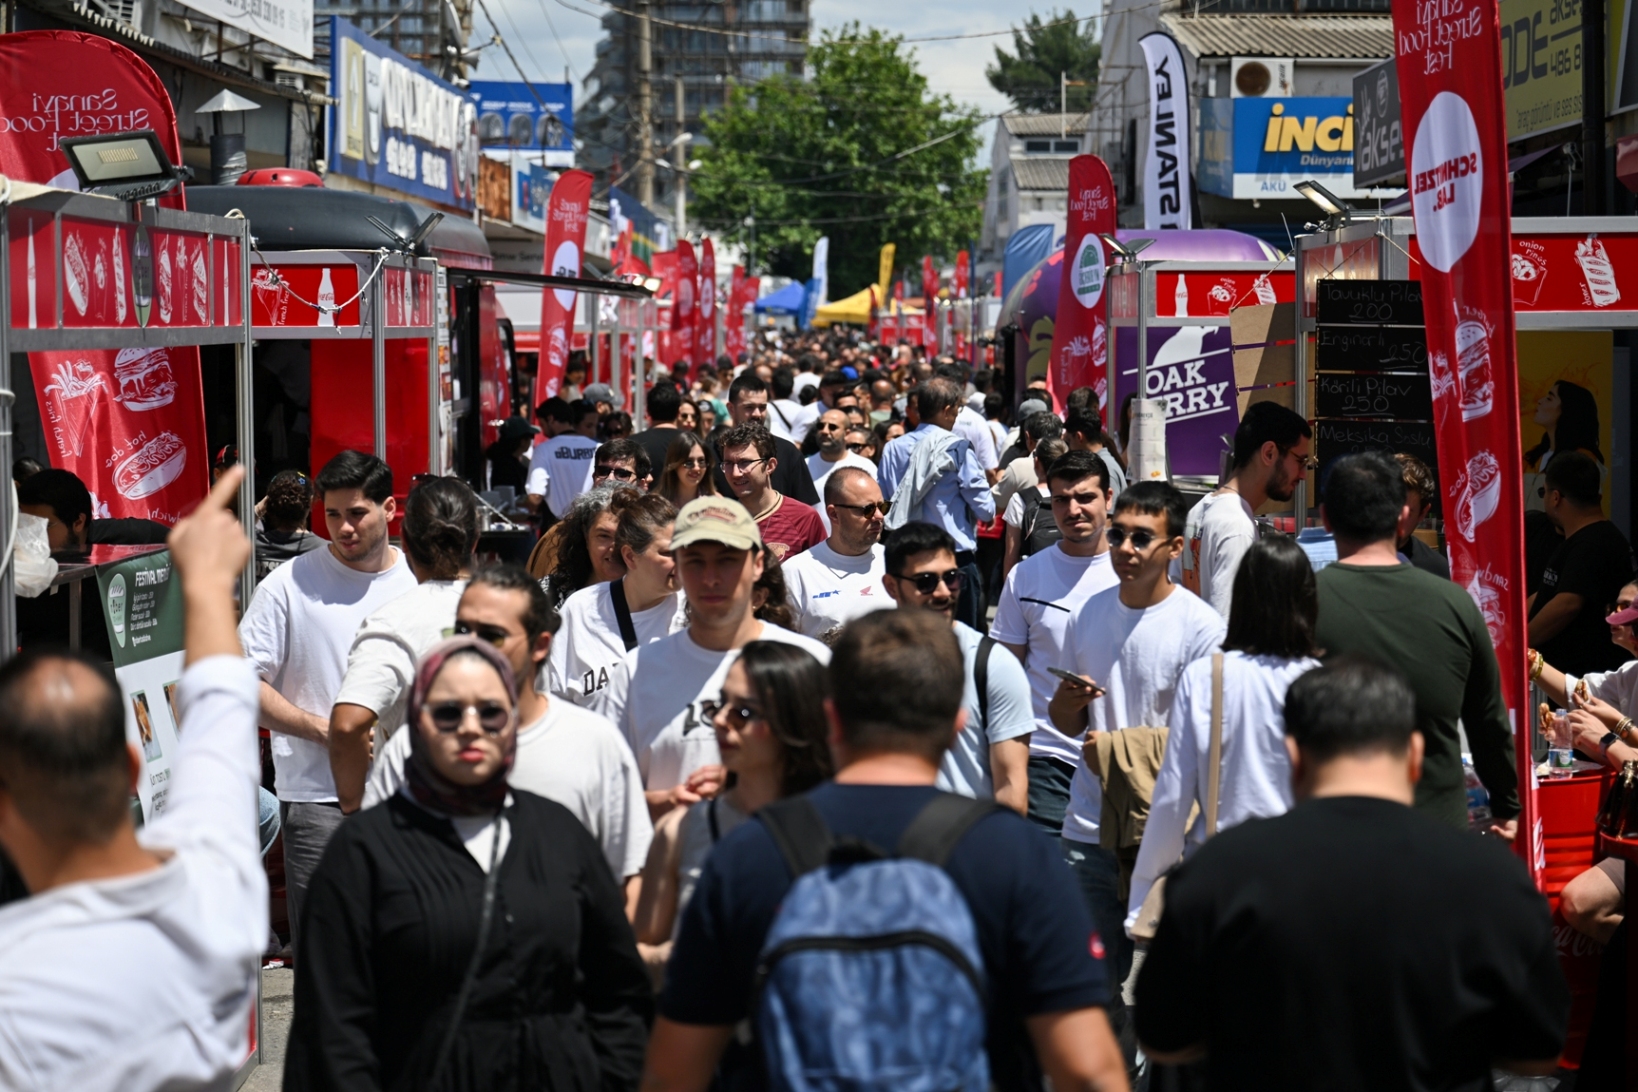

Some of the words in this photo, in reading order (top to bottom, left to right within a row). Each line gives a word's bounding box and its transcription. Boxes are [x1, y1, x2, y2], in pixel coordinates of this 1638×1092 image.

[1550, 48, 1572, 77] 486
[1519, 240, 1545, 252] onion
[1349, 303, 1392, 320] 200
[1379, 341, 1426, 364] 250
[1146, 359, 1206, 395] OAK
[1365, 377, 1412, 396] Pilav
[1150, 381, 1229, 419] RRY
[1342, 395, 1389, 412] 250
